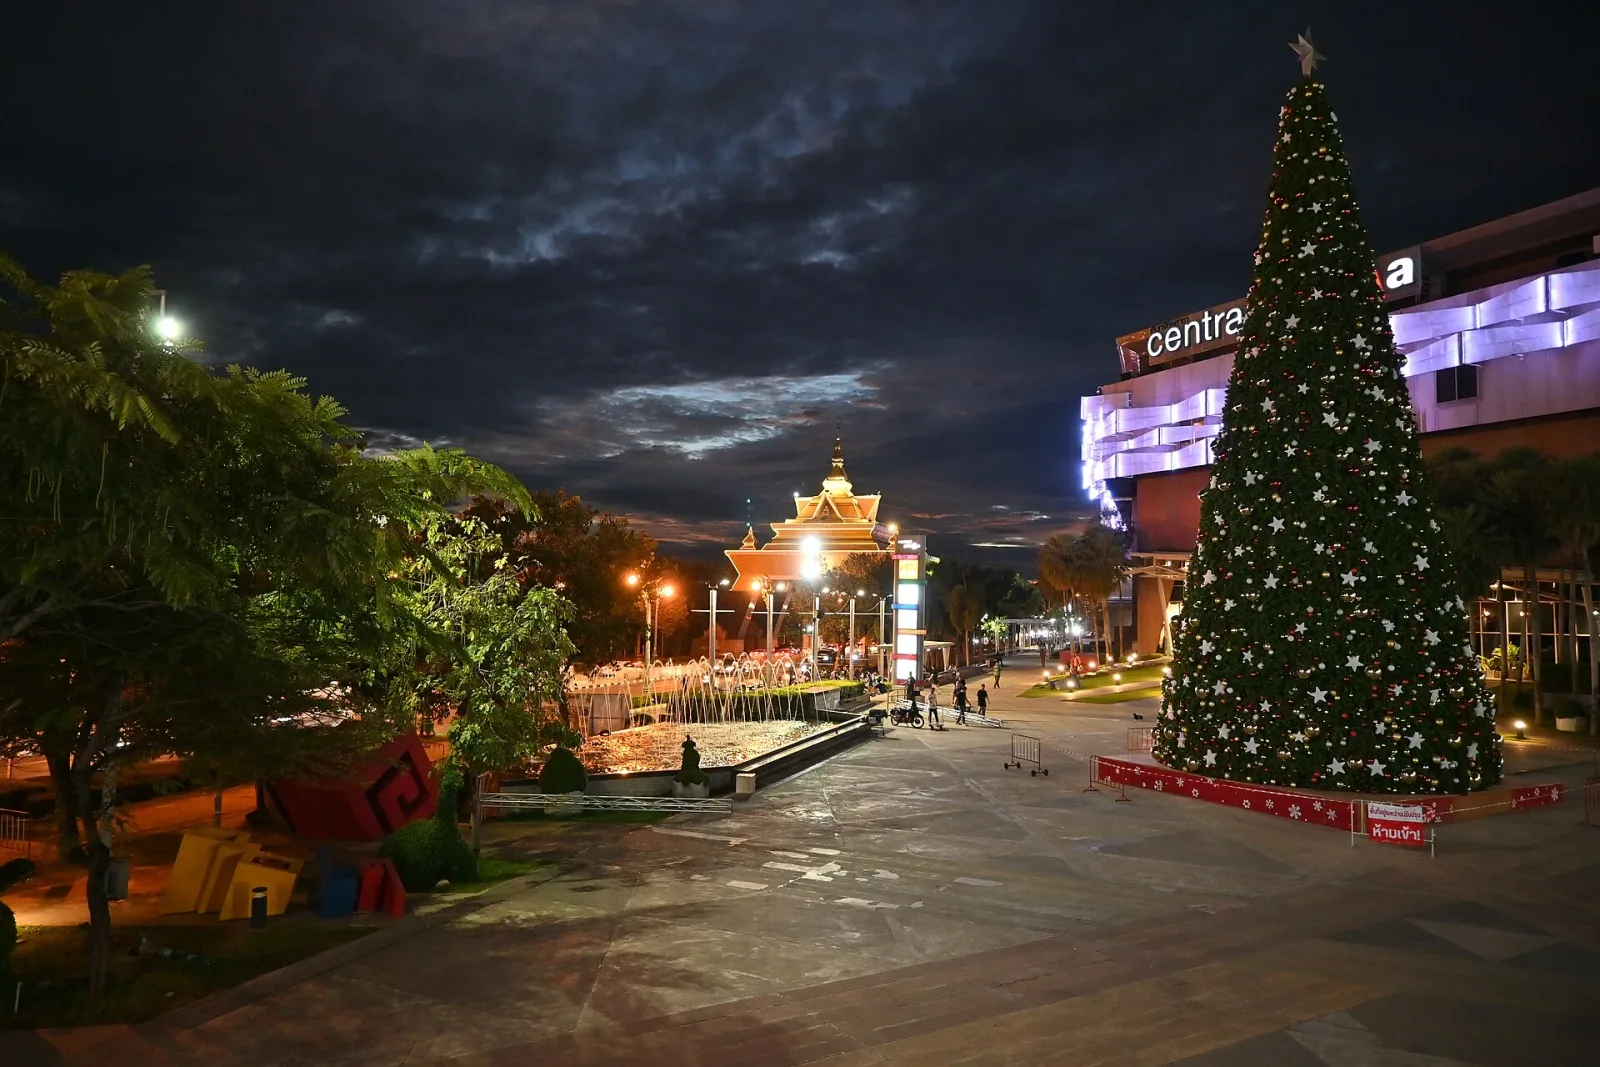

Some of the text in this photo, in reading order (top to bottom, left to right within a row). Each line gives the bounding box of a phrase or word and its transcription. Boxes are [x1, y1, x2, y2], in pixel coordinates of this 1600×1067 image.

[1147, 307, 1243, 357] centra
[1374, 257, 1414, 290] a
[1372, 823, 1421, 841] ห้ามเข้า!
